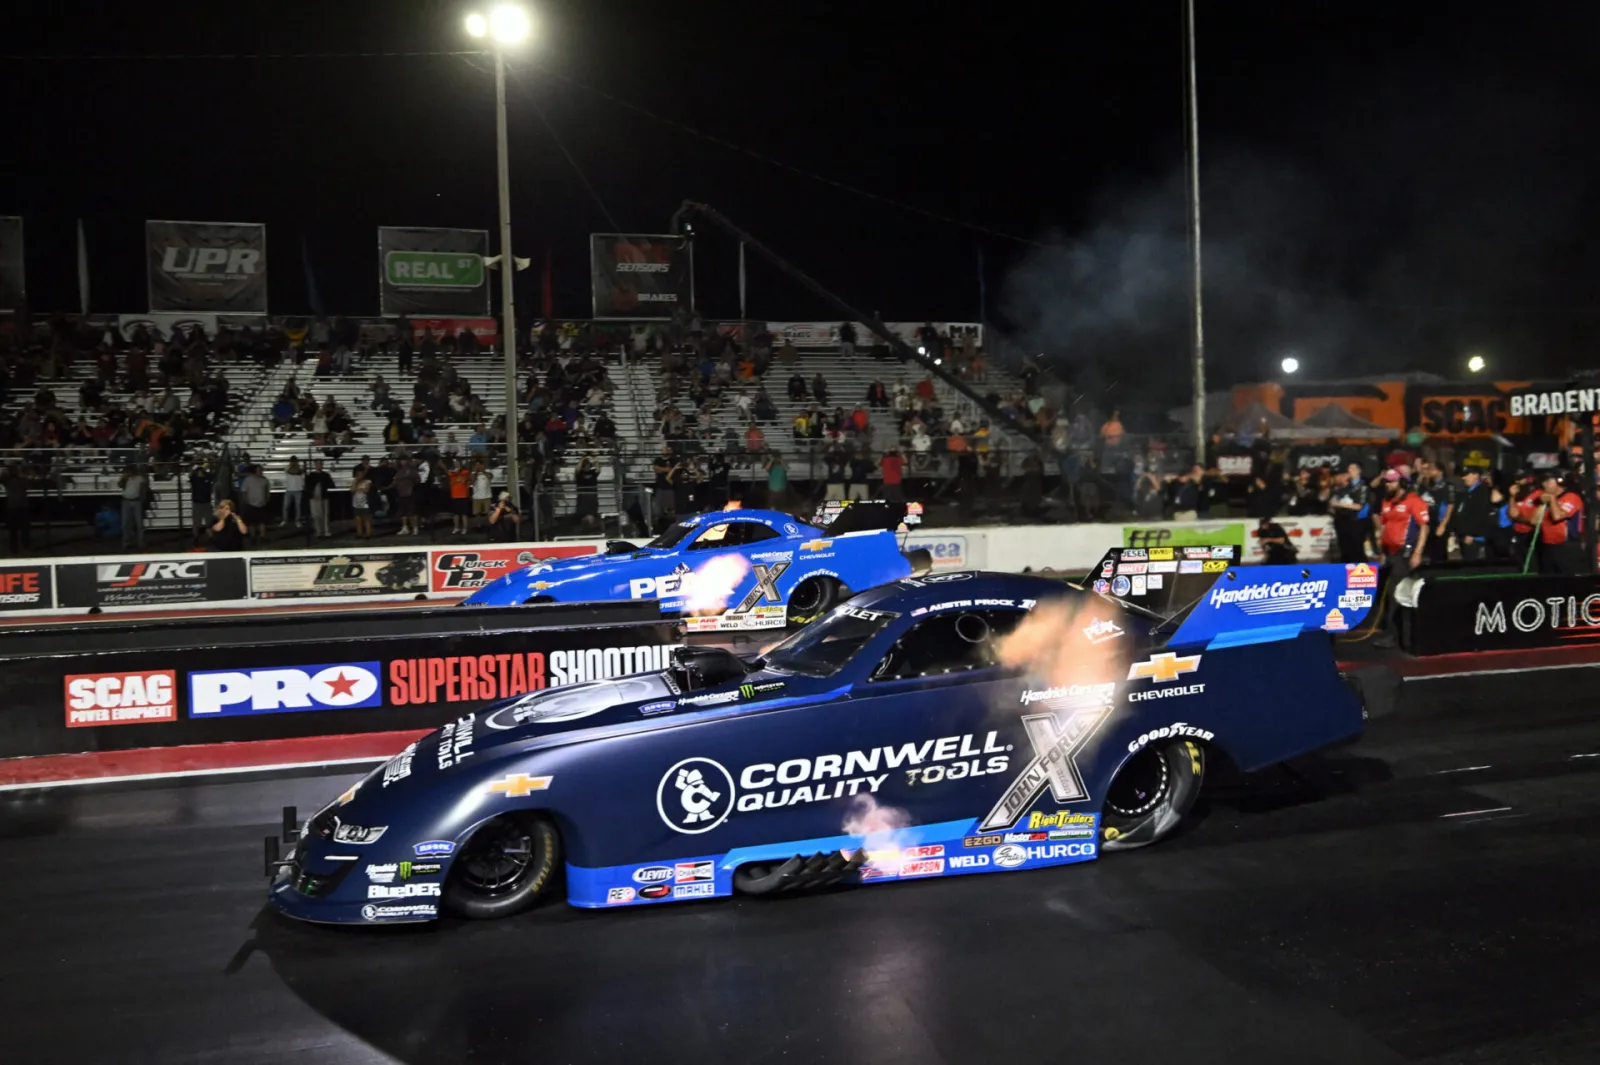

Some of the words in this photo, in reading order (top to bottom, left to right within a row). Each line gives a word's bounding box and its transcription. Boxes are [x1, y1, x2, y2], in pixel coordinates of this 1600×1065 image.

[162, 247, 260, 274] UPR
[394, 261, 454, 279] REAL
[457, 259, 475, 269] ST
[435, 553, 507, 573] QUICK
[799, 552, 836, 561] CHEVROLET
[1121, 549, 1147, 558] JESEL
[928, 600, 972, 612] AUSTIN
[974, 599, 1015, 607] PROCK
[389, 652, 546, 706] SUPERSTAR
[69, 674, 173, 710] SCAG
[191, 665, 378, 714] PRO
[1128, 684, 1205, 702] CHEVROLET
[739, 731, 1006, 790] CORNWELL
[1002, 768, 1043, 818] JOHN
[1038, 716, 1087, 777] FORCE
[736, 773, 890, 813] QUALITY
[905, 755, 1010, 787] TOOLS
[905, 846, 944, 857] ARP
[949, 854, 990, 868] WELD
[1027, 843, 1096, 860] HURCO
[902, 860, 941, 874] SIMPSON
[675, 884, 713, 896] MAHLE
